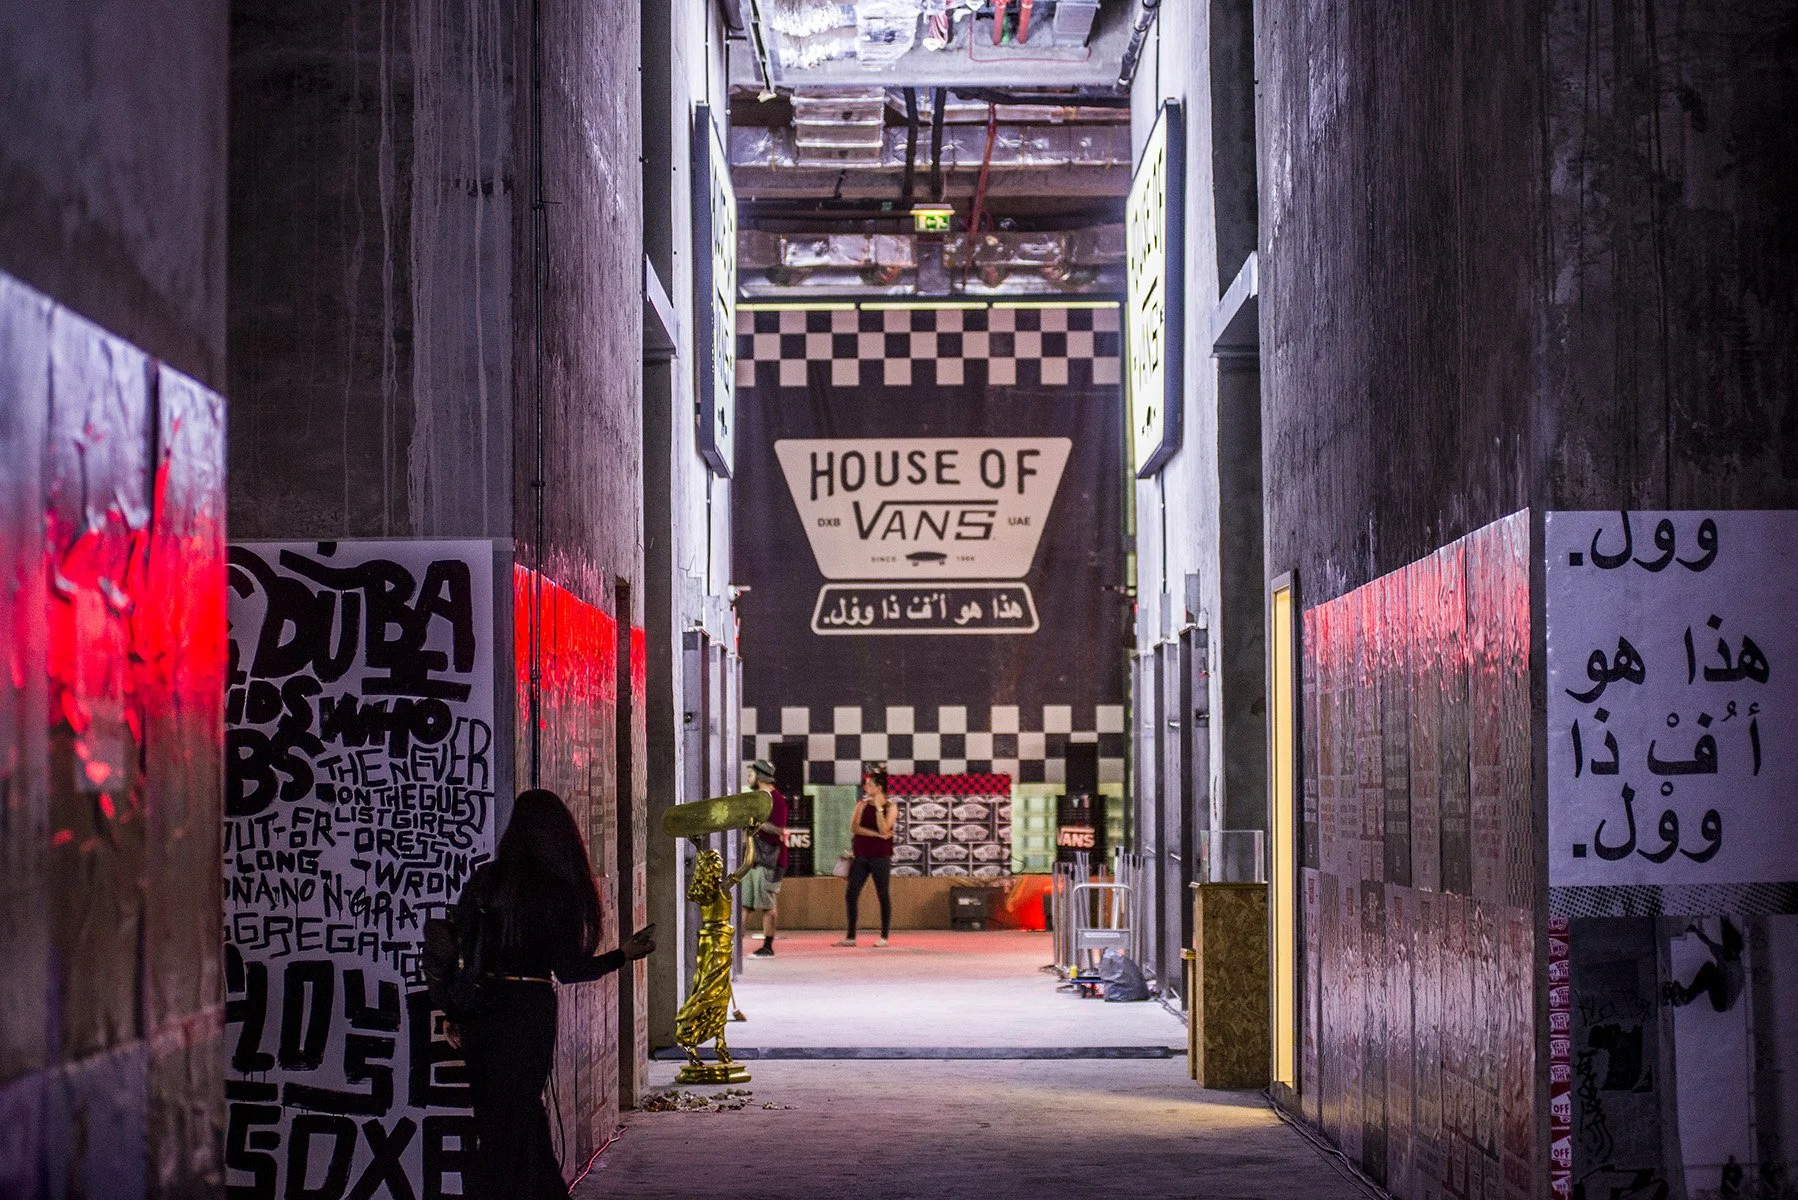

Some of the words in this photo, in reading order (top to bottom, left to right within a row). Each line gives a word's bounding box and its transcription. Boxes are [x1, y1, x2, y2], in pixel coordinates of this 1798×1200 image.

[809, 450, 961, 501] HOUSE
[980, 449, 1041, 495] OF
[817, 517, 841, 528] DXB
[853, 499, 999, 541] VANS
[1008, 516, 1031, 527] UAE
[954, 601, 983, 625] هو
[992, 594, 1023, 620] هذا
[1684, 614, 1770, 685] هذا
[1564, 636, 1646, 704] هو
[319, 692, 452, 758] WHO
[317, 749, 387, 787] THE
[389, 717, 491, 789] NEVER
[1571, 708, 1619, 779] ذا
[335, 806, 392, 826] LIST
[337, 786, 371, 806] ON
[373, 784, 416, 811] THE
[419, 784, 495, 834] GUEST
[1056, 826, 1095, 848] VANS
[1553, 1104, 1569, 1113] OFF
[1553, 1148, 1569, 1158] OFF
